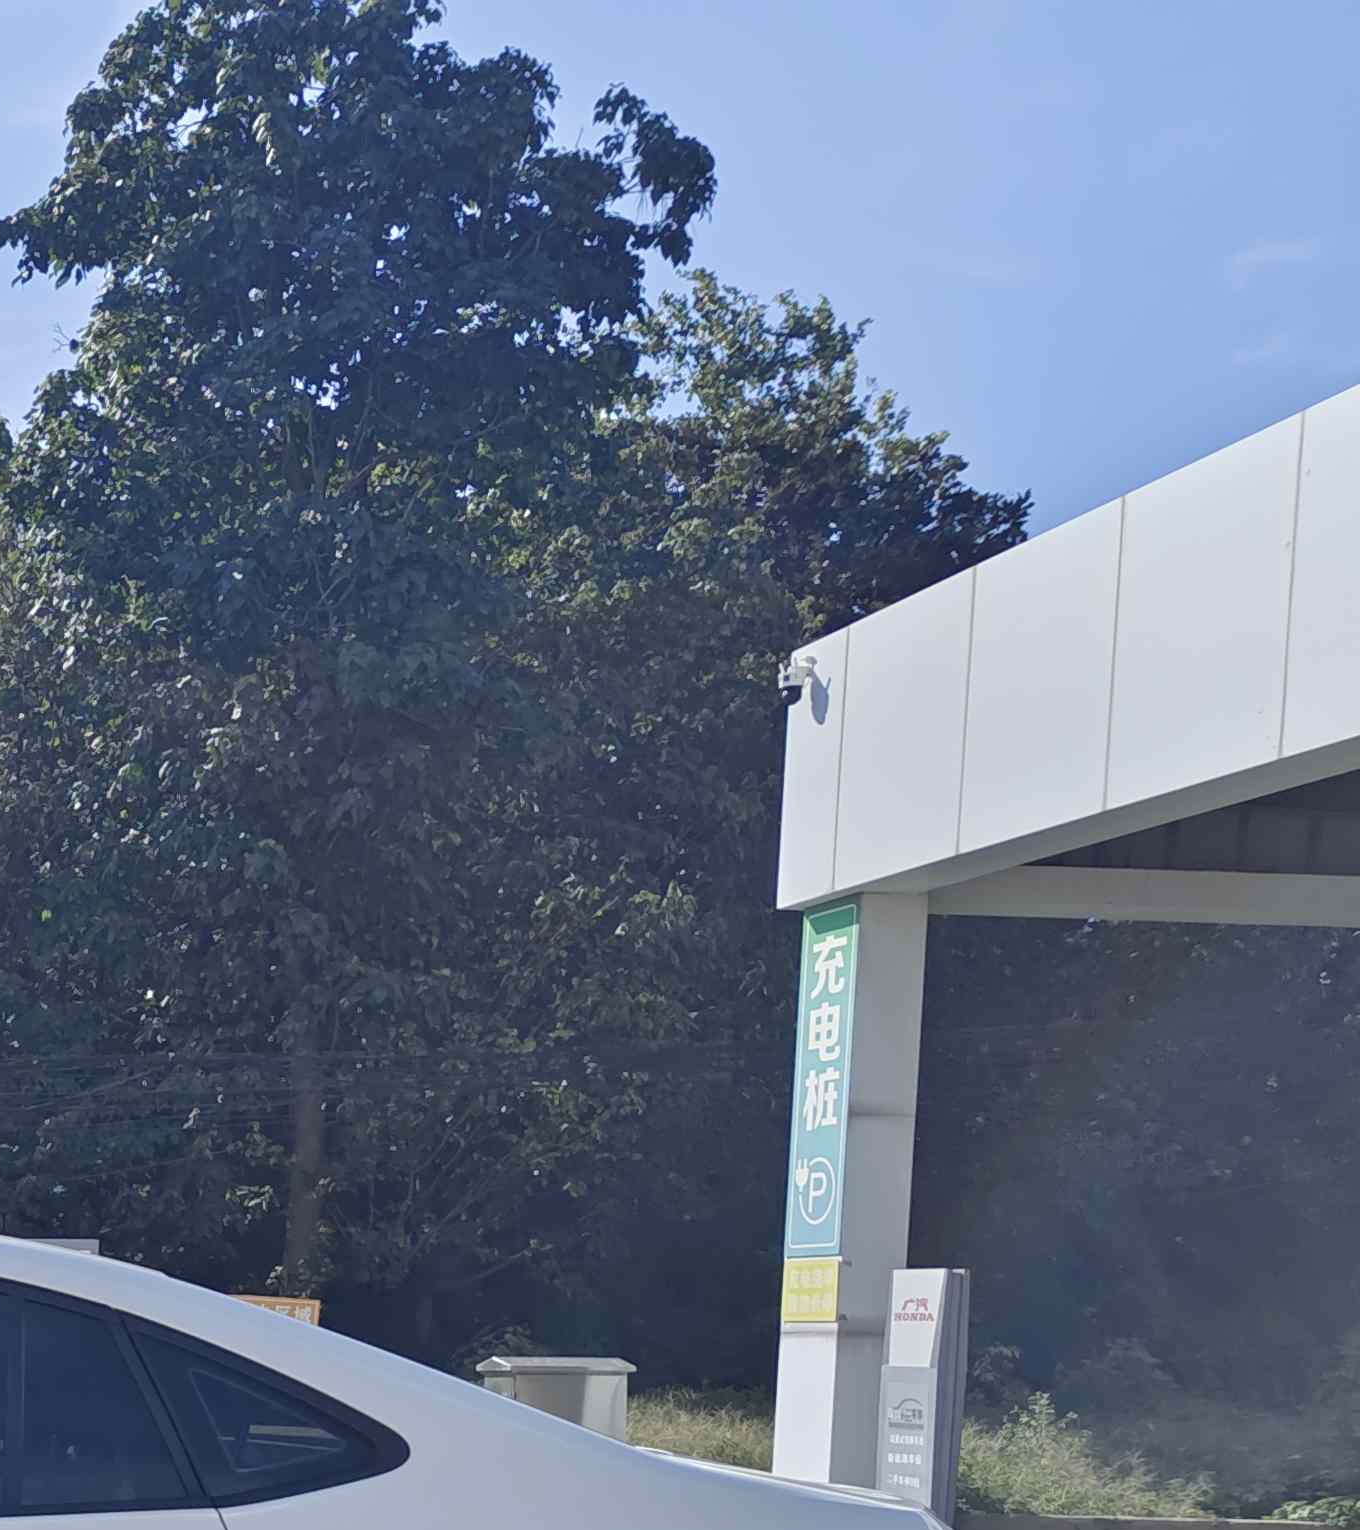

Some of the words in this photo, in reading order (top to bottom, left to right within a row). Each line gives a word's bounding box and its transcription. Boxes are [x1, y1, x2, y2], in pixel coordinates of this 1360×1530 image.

[802, 934, 848, 1132] 充电桩
[807, 1171, 828, 1213] P
[894, 1312, 935, 1322] HONDA
[901, 1298, 929, 1311] 广汽
